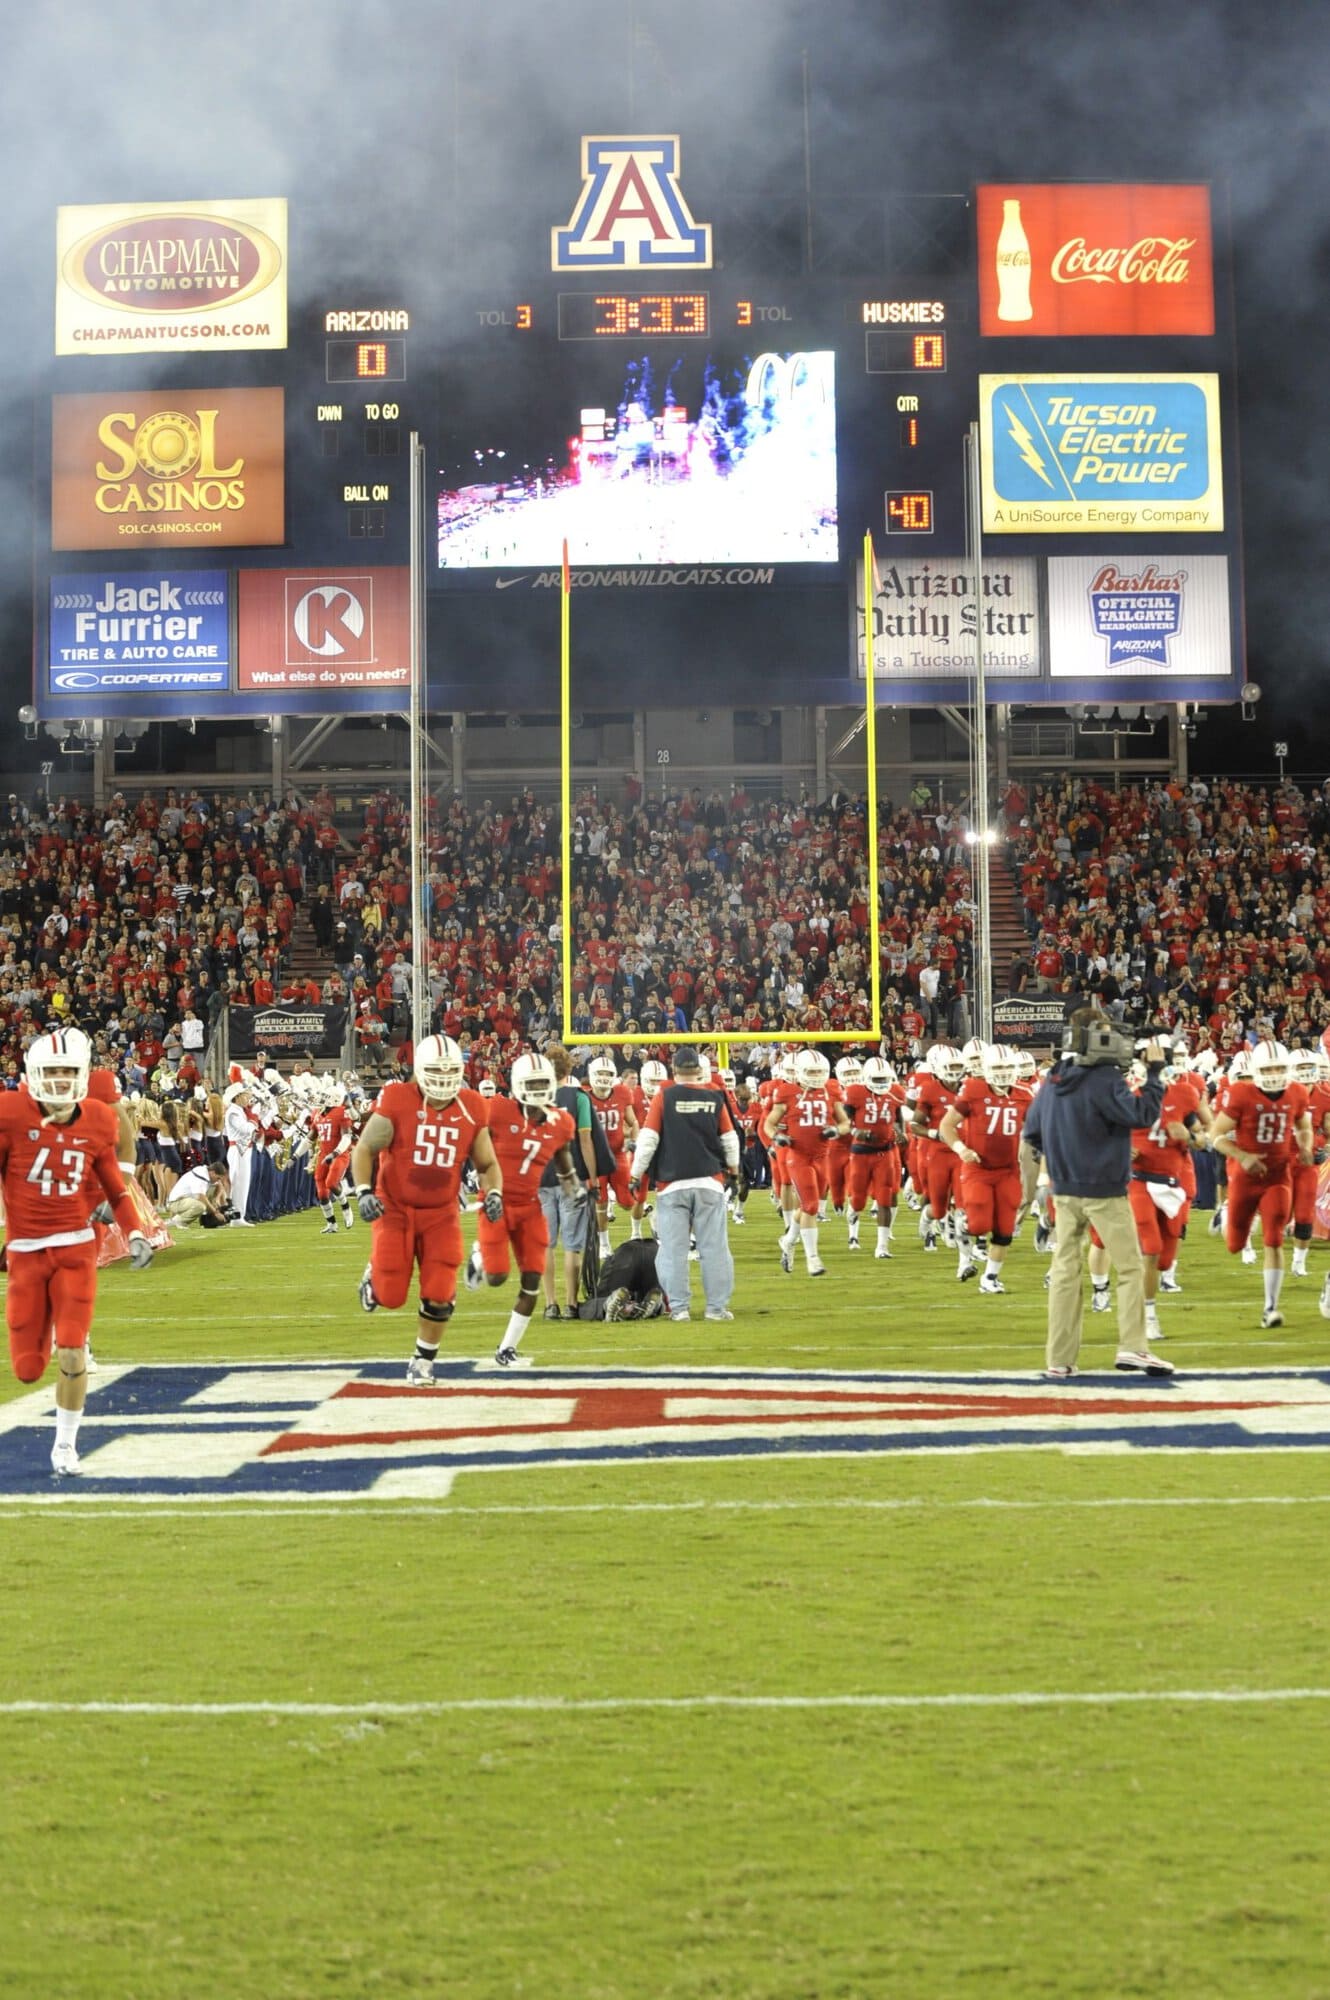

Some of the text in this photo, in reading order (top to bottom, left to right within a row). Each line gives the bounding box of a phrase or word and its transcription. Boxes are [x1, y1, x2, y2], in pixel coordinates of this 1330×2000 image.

[100, 237, 242, 276] CHAPMAN
[1050, 237, 1197, 284] Coca-Cola
[104, 275, 240, 292] AUTOMOTIVE
[325, 310, 409, 331] ARIZONA
[476, 311, 511, 325] TOL
[516, 305, 531, 328] 3
[595, 296, 705, 333] 3:33
[737, 302, 752, 325] 3
[757, 306, 792, 321] TOL
[863, 302, 945, 323] HUSKIES
[72, 323, 271, 341] CHAPMANTUCSON.COM
[356, 343, 387, 376] 0
[914, 335, 943, 367] 0
[317, 405, 342, 421] DWN
[365, 403, 399, 420] TO GO
[896, 395, 919, 412] QTR
[1046, 396, 1157, 425] Tucson
[910, 418, 917, 446] 1
[1058, 427, 1188, 454] Electric
[95, 409, 244, 481] SOL
[1072, 457, 1188, 483] Power
[95, 480, 245, 513] CASINOS
[344, 486, 388, 502] BALL ON
[889, 495, 930, 528] 40
[994, 509, 1210, 525] A UniSource Energy Company
[118, 522, 222, 535] SOLCASINOS.COM
[532, 568, 775, 588] ARZONAWILDCATS.COM
[1092, 567, 1184, 592] Bashas'
[96, 581, 182, 612] Jack
[1098, 597, 1175, 609] OFFICIAL
[75, 611, 203, 642] Furrier
[1098, 610, 1175, 622] TAILGATE
[1099, 622, 1175, 631] HEADQUARTERS
[61, 645, 218, 660] TIRE & AUTO CARE
[1112, 640, 1163, 650] ARIZONA
[893, 655, 904, 668] a
[910, 651, 975, 667] Tucson
[252, 668, 407, 683] What else do you need?
[656, 749, 670, 764] 28
[1275, 742, 1288, 757] 29
[41, 761, 53, 775] 27
[296, 1017, 324, 1025] FAMILY
[675, 1100, 716, 1114] ESPN
[798, 1100, 827, 1126] 33
[864, 1102, 892, 1124] 34
[985, 1106, 1018, 1136] 76
[1256, 1113, 1287, 1144] 61
[413, 1124, 460, 1168] 55
[519, 1138, 541, 1175] 7
[26, 1147, 86, 1196] 43
